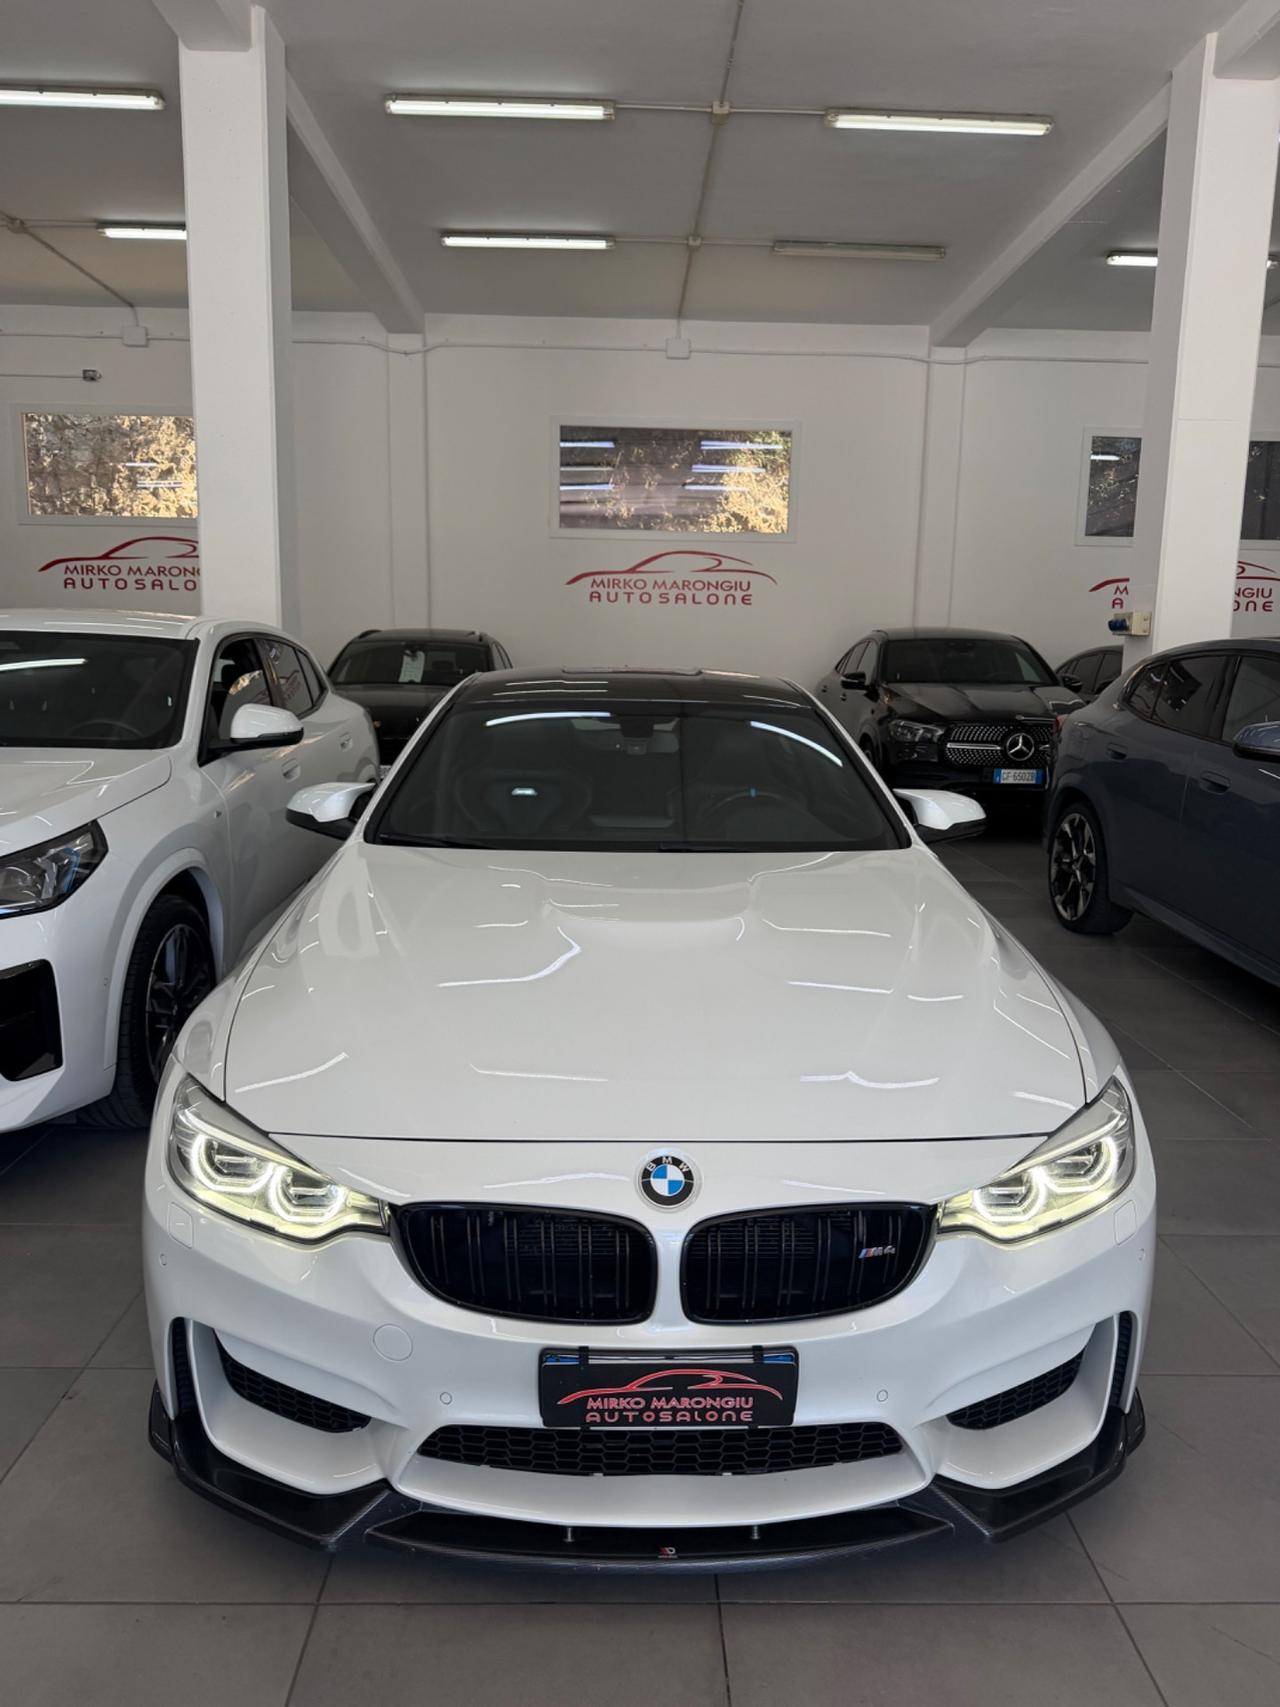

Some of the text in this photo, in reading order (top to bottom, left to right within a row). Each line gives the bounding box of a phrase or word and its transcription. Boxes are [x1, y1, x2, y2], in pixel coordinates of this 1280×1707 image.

[64, 564, 122, 577] MIRKO
[590, 578, 752, 592] MIRKO MARONGIU
[589, 591, 753, 606] AUTOSALONE
[646, 1155, 690, 1172] BMW
[586, 1396, 754, 1410] MIRKO MARONGIU
[585, 1410, 754, 1423] AUTOSALONE
